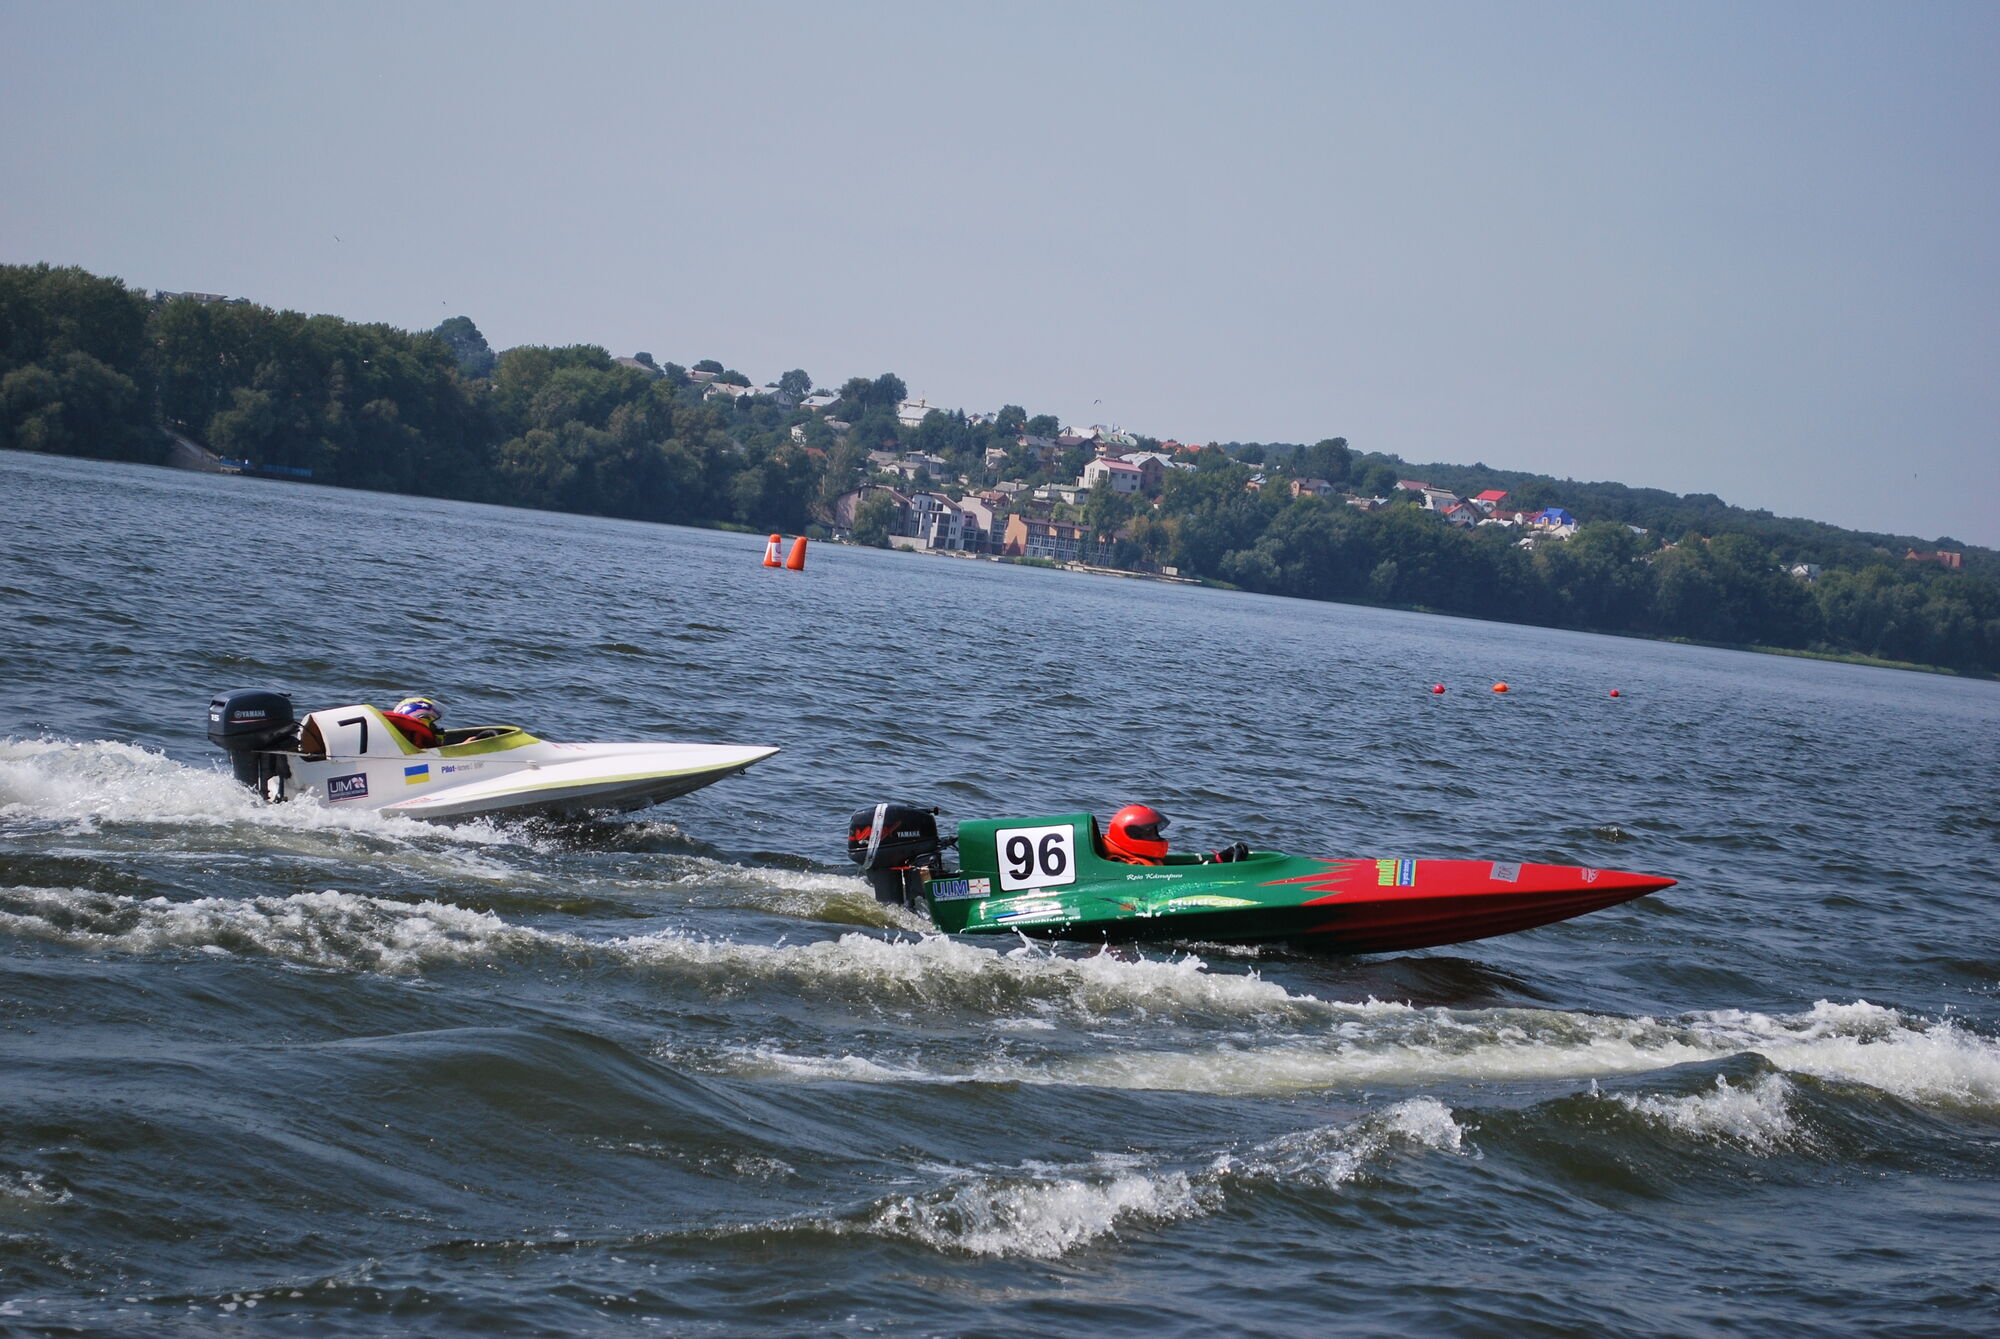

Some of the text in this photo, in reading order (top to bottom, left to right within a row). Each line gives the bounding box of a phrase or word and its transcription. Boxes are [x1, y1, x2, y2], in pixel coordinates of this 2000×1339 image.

[211, 714, 220, 722] 15
[242, 710, 265, 718] YAMAHA
[337, 716, 368, 755] 7
[329, 779, 353, 793] UIM
[897, 830, 920, 838] YAMAHA
[1005, 833, 1066, 881] 96
